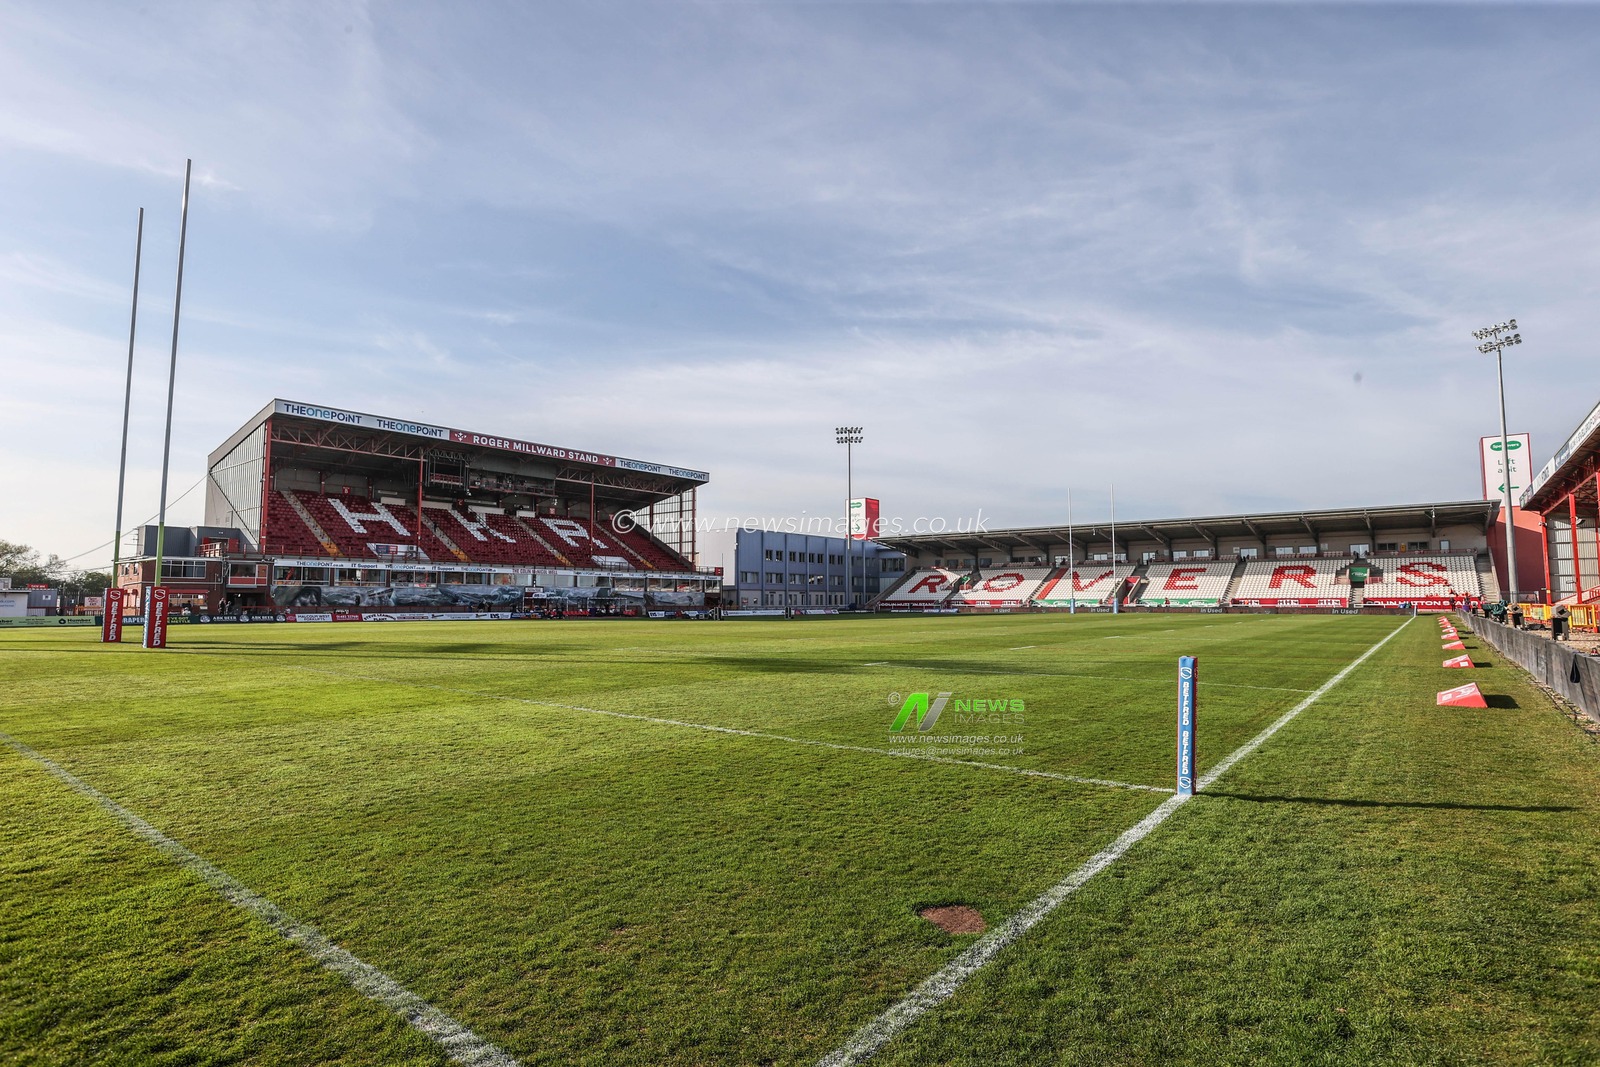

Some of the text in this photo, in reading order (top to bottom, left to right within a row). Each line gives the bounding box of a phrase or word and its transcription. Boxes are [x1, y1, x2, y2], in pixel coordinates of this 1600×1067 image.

[473, 435, 599, 463] ROGER MILLWARD STAND
[109, 601, 119, 641] BETFRED
[153, 601, 164, 646] BETFRED
